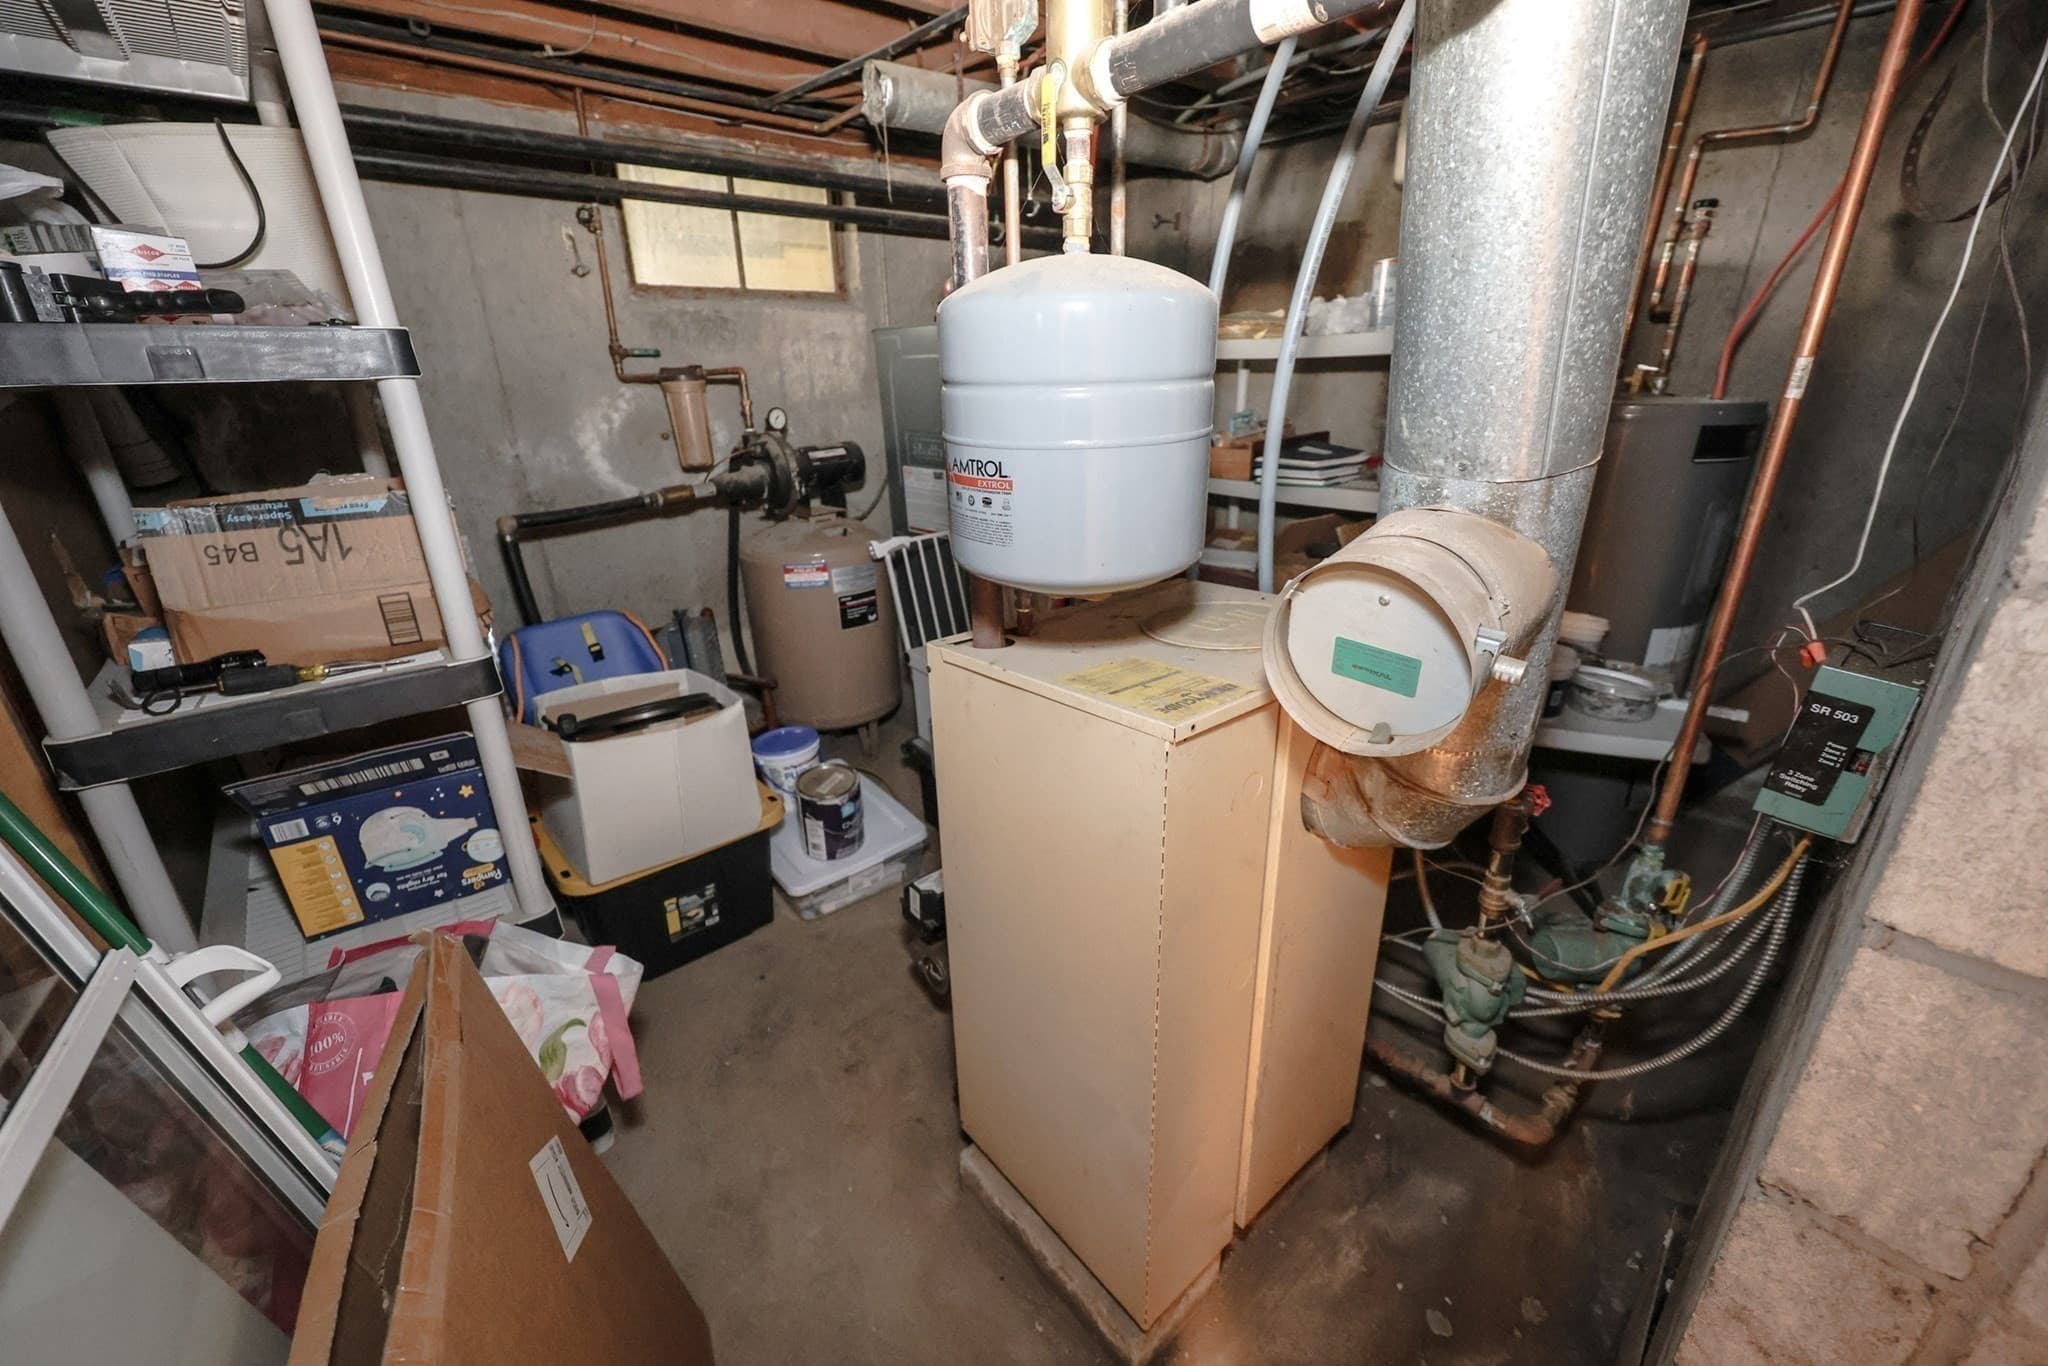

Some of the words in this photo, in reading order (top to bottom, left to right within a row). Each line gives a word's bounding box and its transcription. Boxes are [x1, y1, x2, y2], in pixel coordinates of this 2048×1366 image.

[952, 457, 1009, 479] AMTROL
[977, 479, 1012, 490] EXTROL
[246, 502, 289, 512] returns
[226, 510, 293, 524] Super-easy
[278, 523, 352, 565] 1A5
[204, 541, 259, 566] B45
[1810, 703, 1831, 716] SR
[1833, 710, 1859, 724] 503
[1778, 772, 1818, 790] Switching
[1793, 771, 1815, 783] Zone
[1784, 780, 1807, 793] Relay
[461, 868, 503, 887] Pampers
[310, 1031, 345, 1058] 100%
